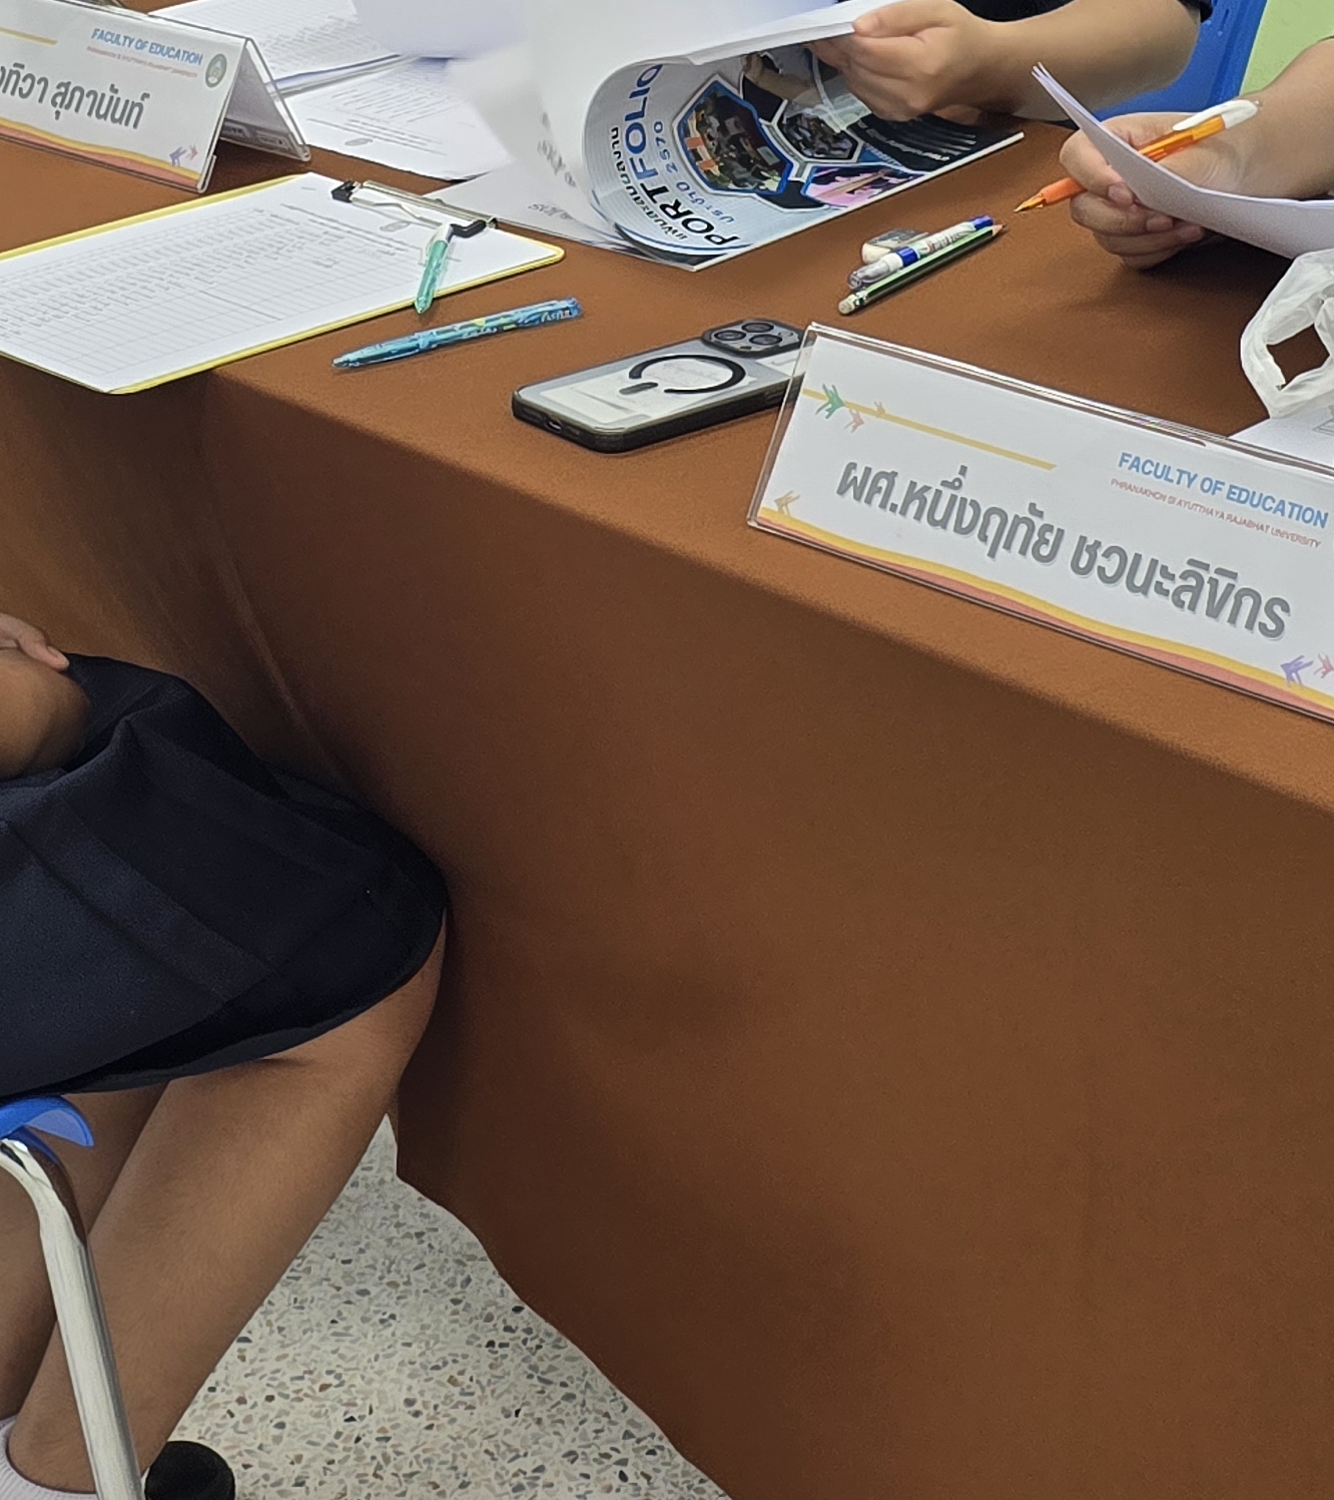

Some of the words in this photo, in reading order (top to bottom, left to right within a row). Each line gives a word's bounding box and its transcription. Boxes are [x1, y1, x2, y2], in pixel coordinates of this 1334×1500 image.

[91, 28, 134, 47] FACULTY
[135, 38, 149, 50] OF
[148, 42, 204, 65] EDUCATION
[50, 81, 151, 130] สุภานันท์
[624, 64, 740, 246] PORTFOLIO
[1118, 452, 1198, 488] FACULTY
[1199, 477, 1225, 496] OF
[1226, 484, 1329, 528] EDUCATION
[1176, 499, 1225, 521] AYUTTHAYA
[836, 461, 1065, 565] ผศ.หนึ่งฤทัย
[1070, 534, 1291, 639] ชวนะลิขิกร
